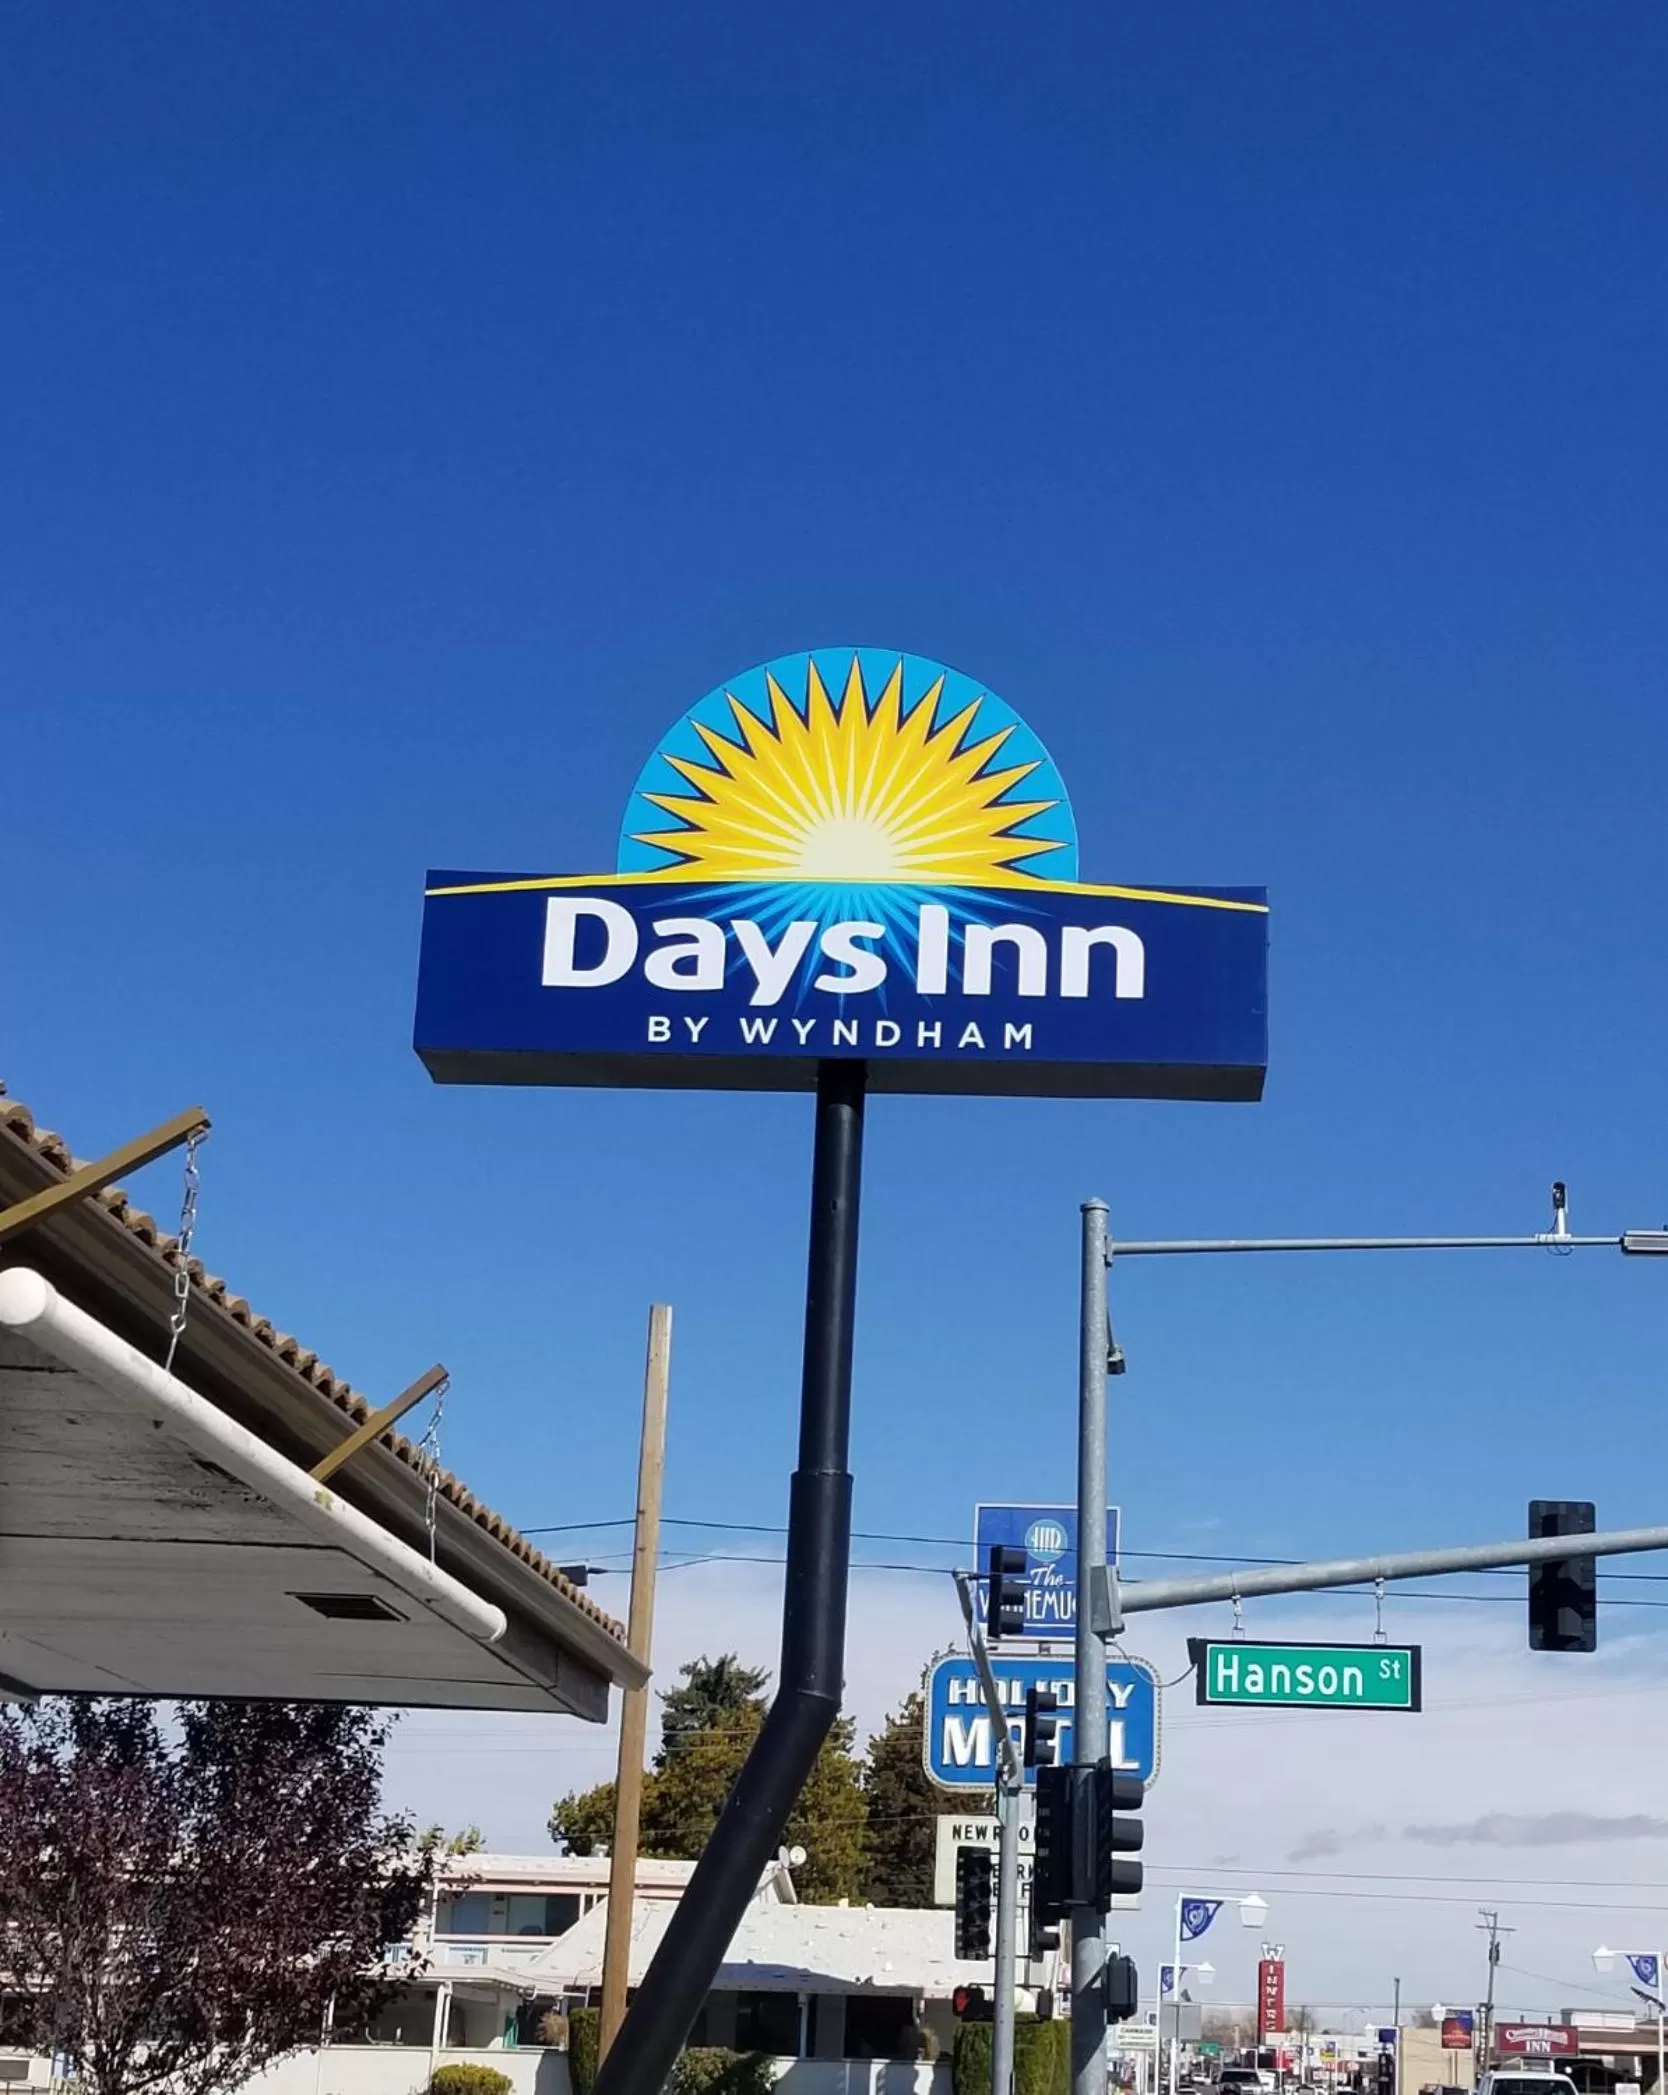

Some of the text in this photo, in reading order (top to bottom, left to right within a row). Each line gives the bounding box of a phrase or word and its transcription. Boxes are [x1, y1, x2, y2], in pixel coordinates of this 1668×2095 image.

[542, 896, 1145, 1006] Days Inn
[648, 1016, 1032, 1050] BY WYNDHAM
[1030, 1563, 1064, 1588] The
[1217, 1653, 1401, 1697] Hanson St
[942, 1716, 1141, 1770] MOTL
[952, 1824, 988, 1841] NEW
[1525, 2040, 1552, 2053] INN
